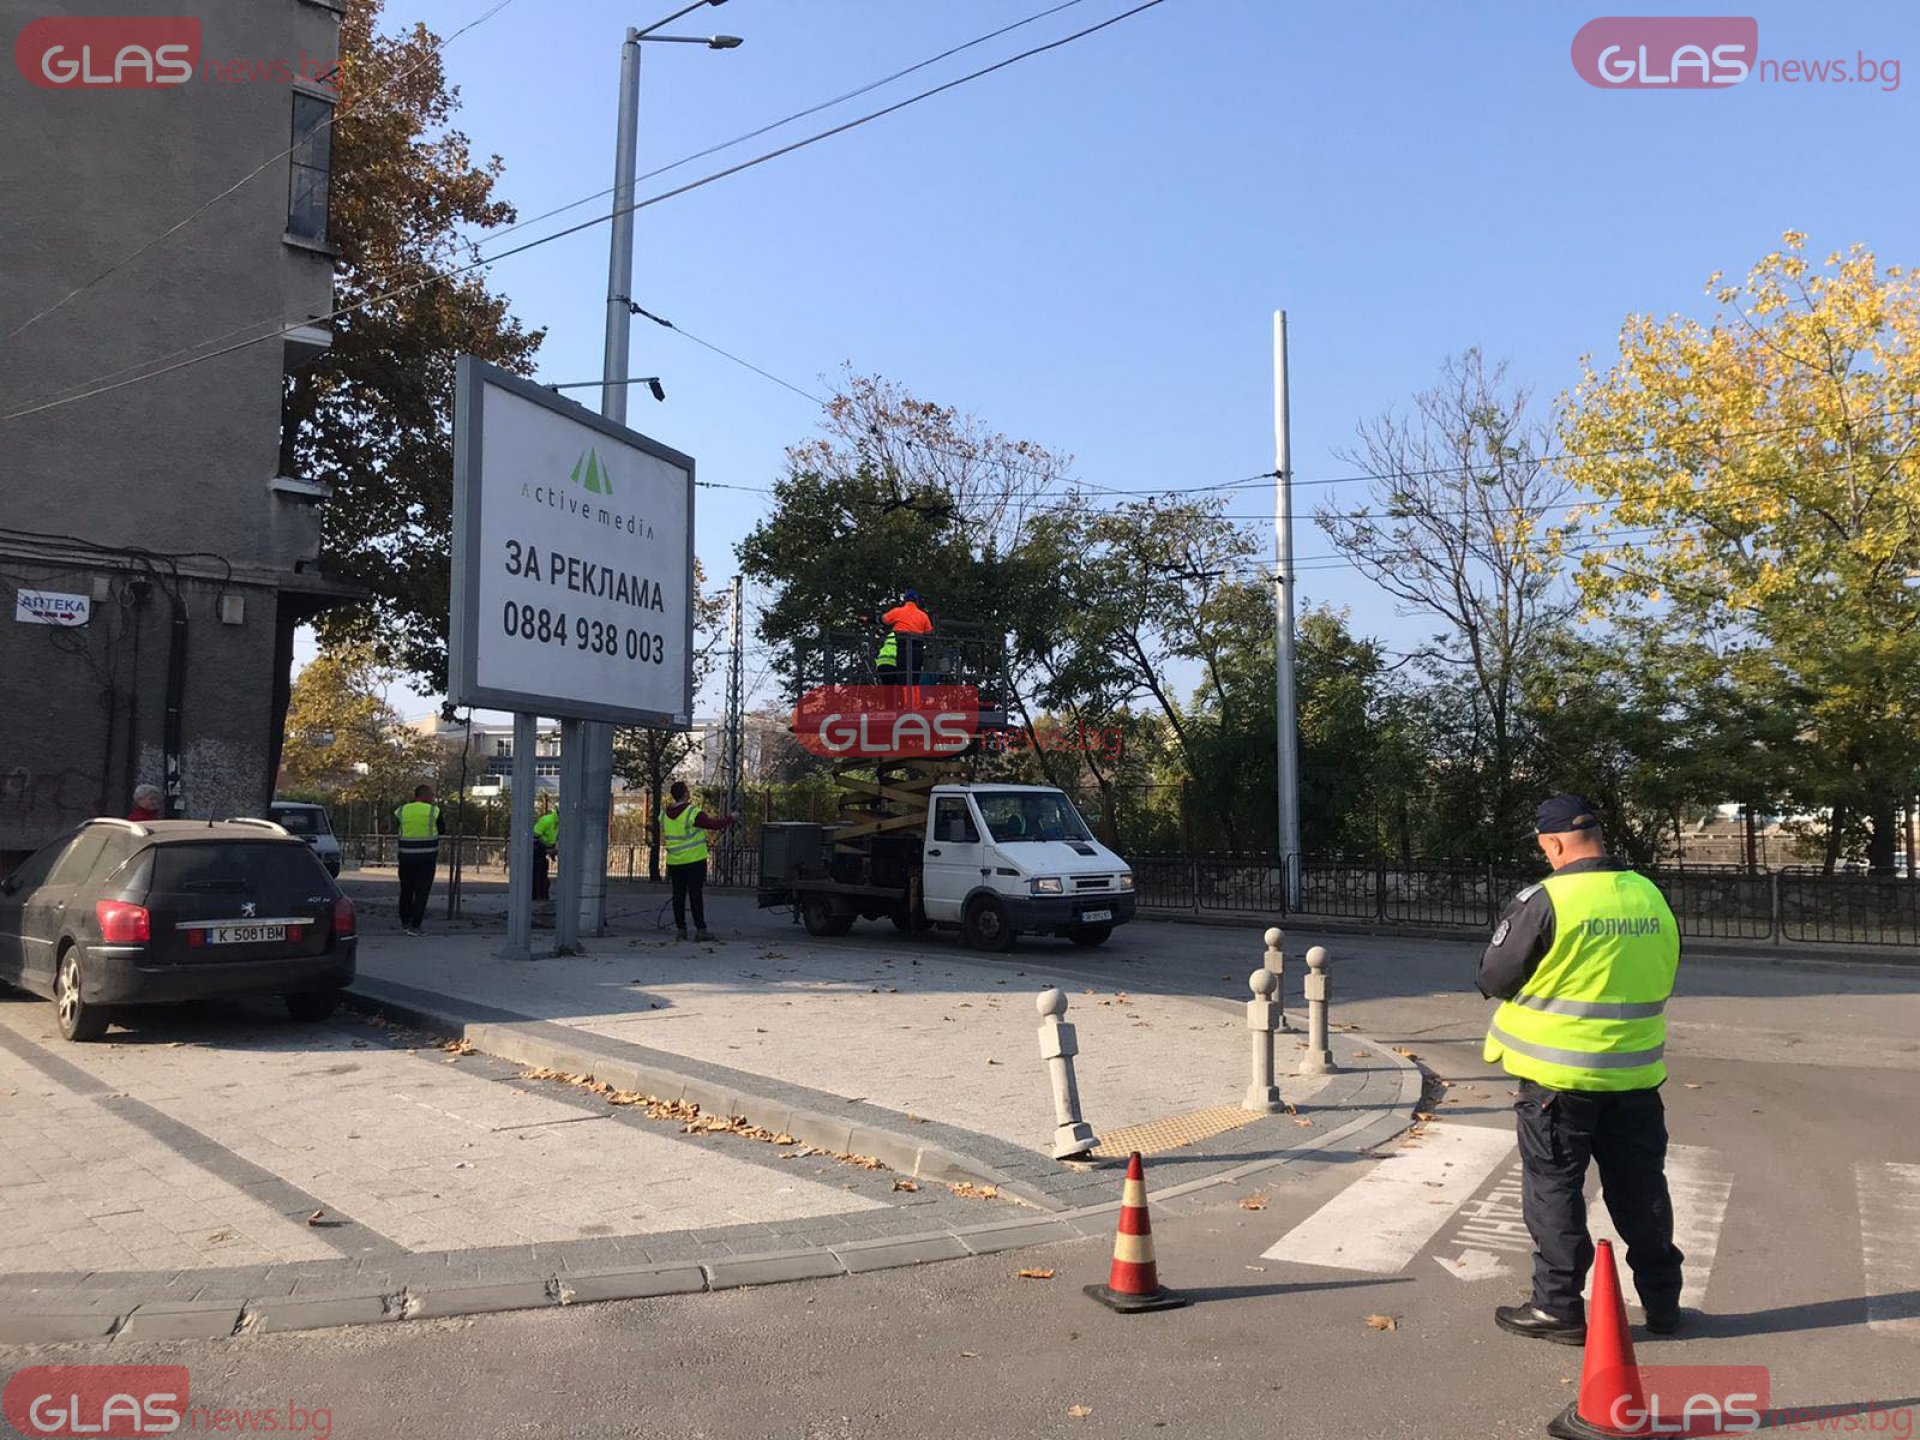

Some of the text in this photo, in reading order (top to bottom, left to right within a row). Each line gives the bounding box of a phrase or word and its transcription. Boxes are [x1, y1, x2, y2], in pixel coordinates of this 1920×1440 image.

[505, 539, 665, 613] ЗА РЕКЛАМА
[21, 596, 86, 612] АПТЕКА
[504, 600, 664, 665] 0884 938 003
[1580, 917, 1660, 937] ПОЛИЦИЯ
